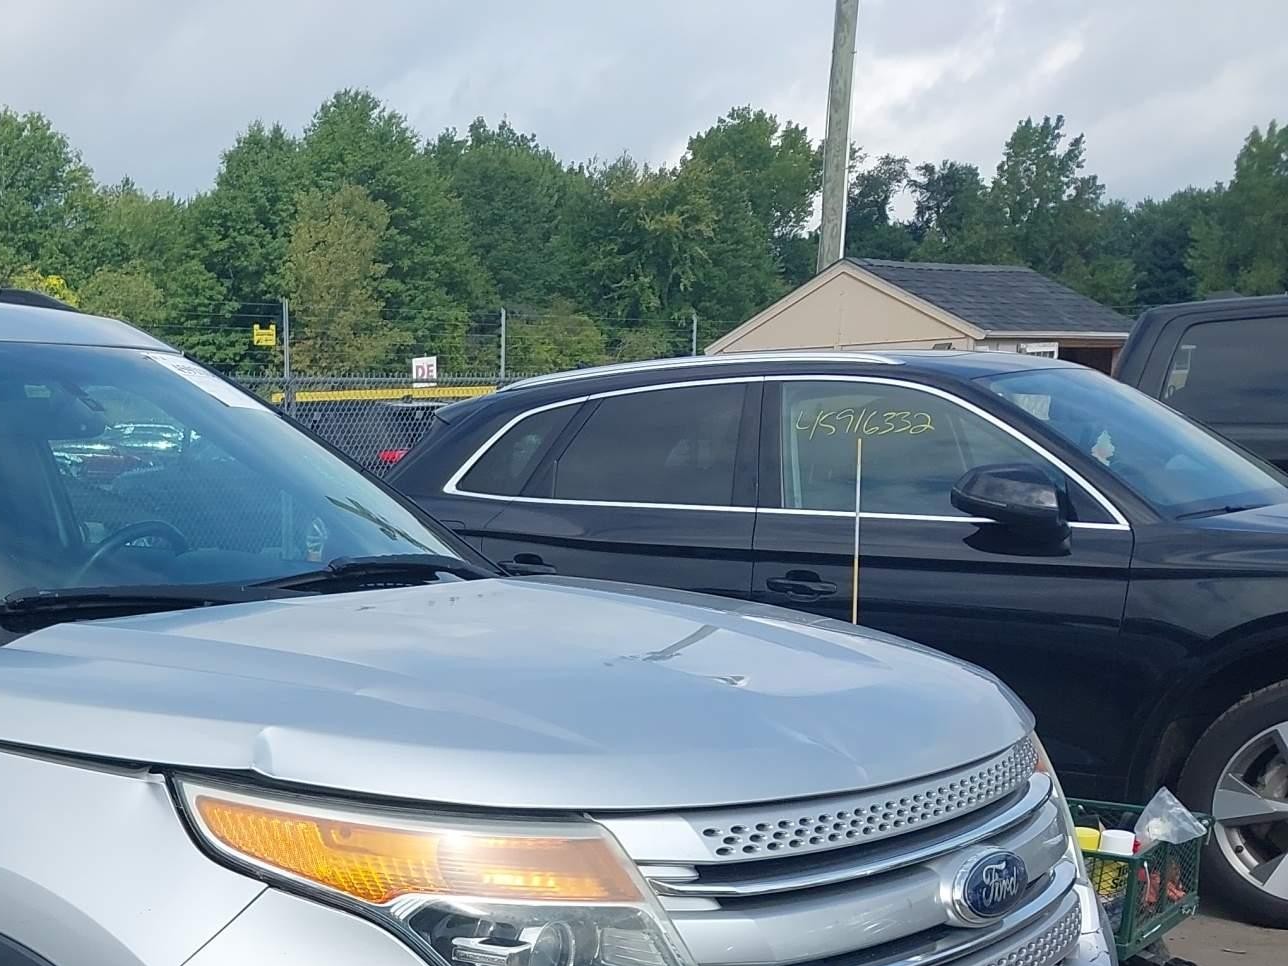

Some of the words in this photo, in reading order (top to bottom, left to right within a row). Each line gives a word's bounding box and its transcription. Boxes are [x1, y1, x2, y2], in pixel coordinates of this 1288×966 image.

[415, 363, 434, 378] DE
[795, 407, 935, 440] 45916332
[981, 859, 1019, 907] Ford
